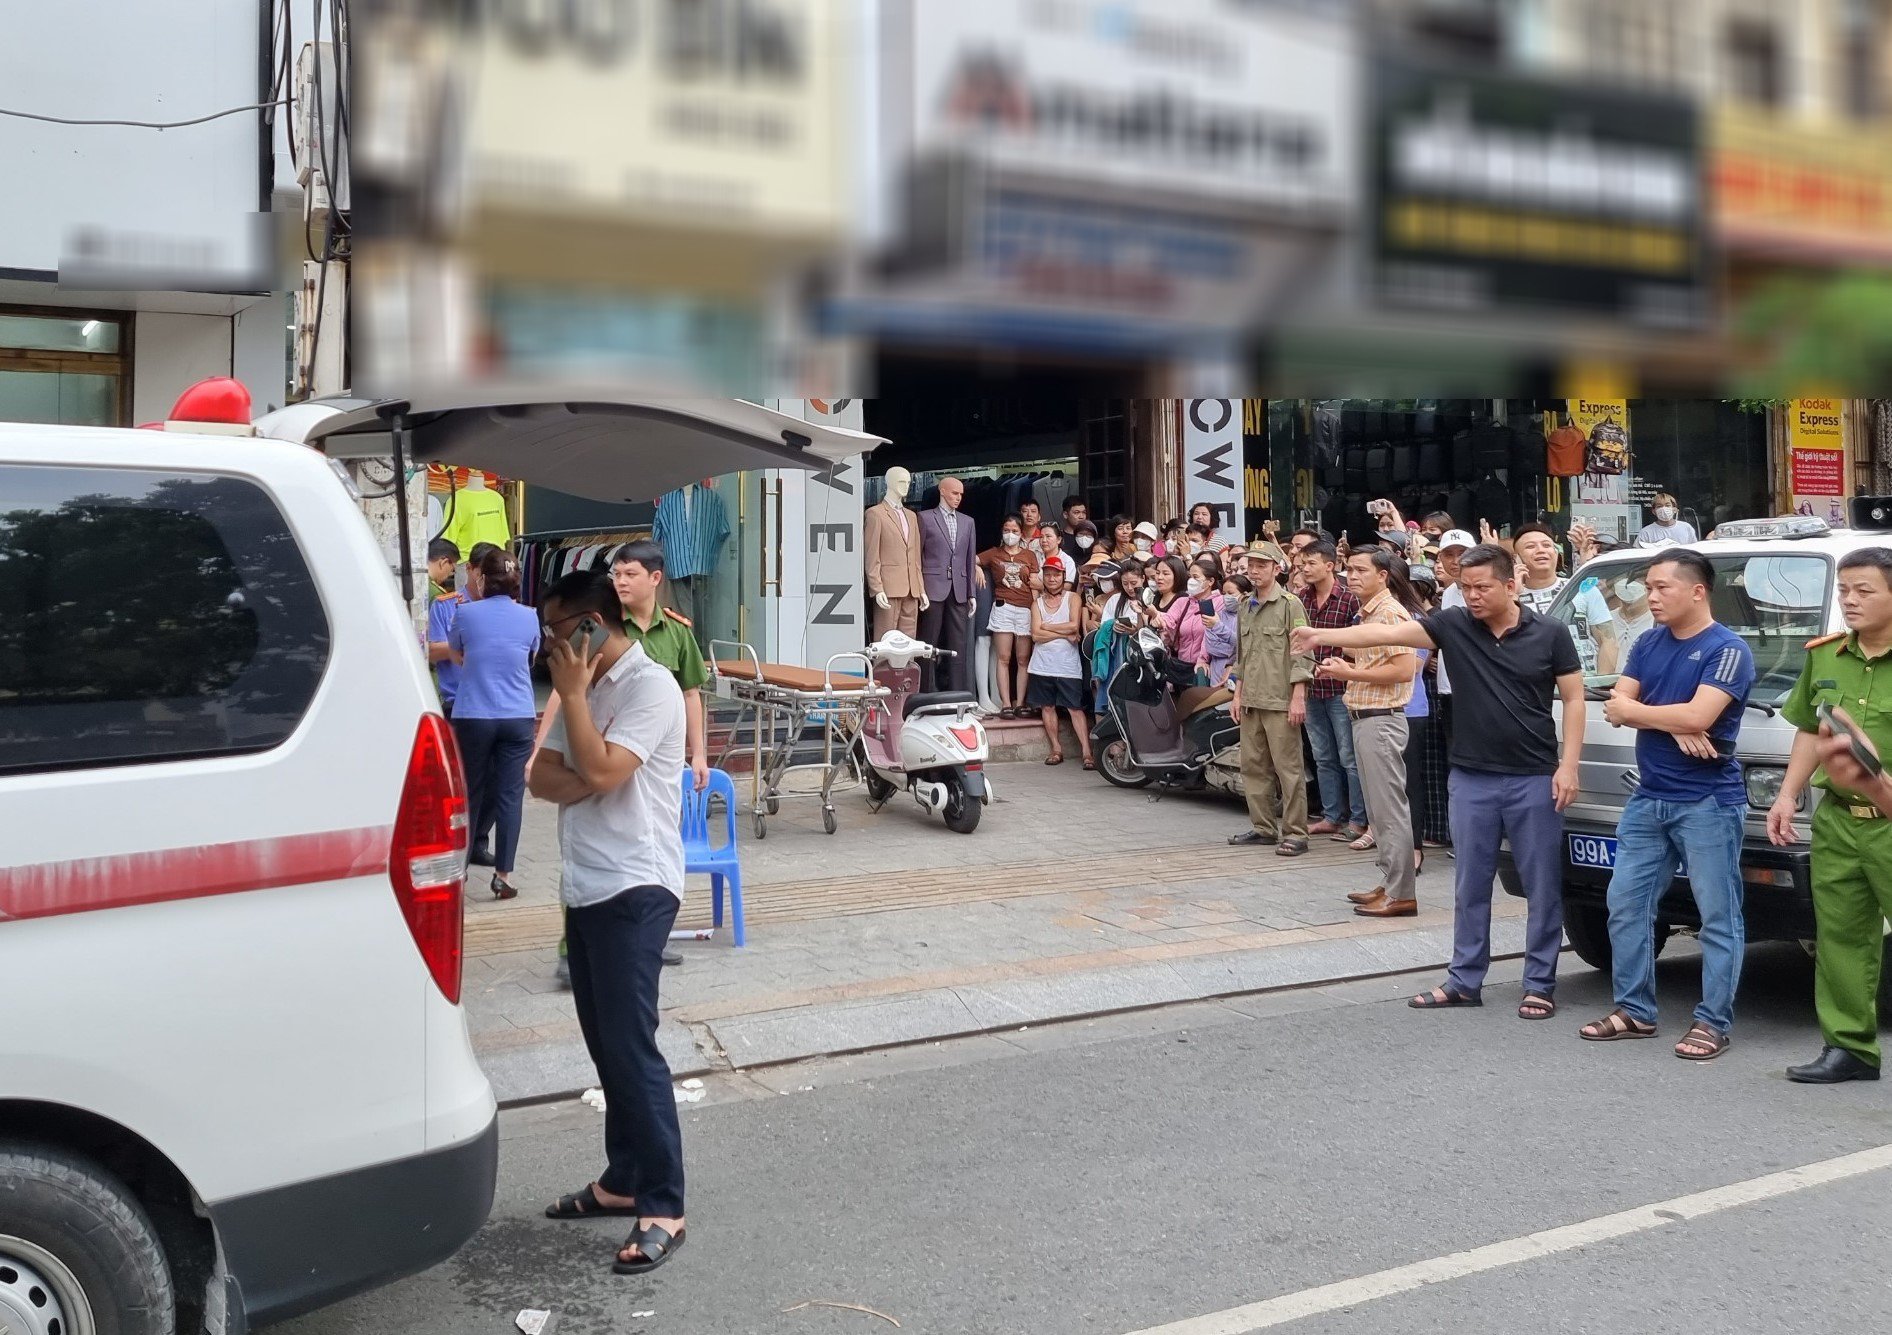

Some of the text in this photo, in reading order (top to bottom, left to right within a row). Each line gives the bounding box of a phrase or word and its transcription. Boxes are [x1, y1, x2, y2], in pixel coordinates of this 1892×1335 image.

[1579, 399, 1622, 417] Express
[1799, 399, 1832, 410] Kodak
[1799, 411, 1839, 427] Express
